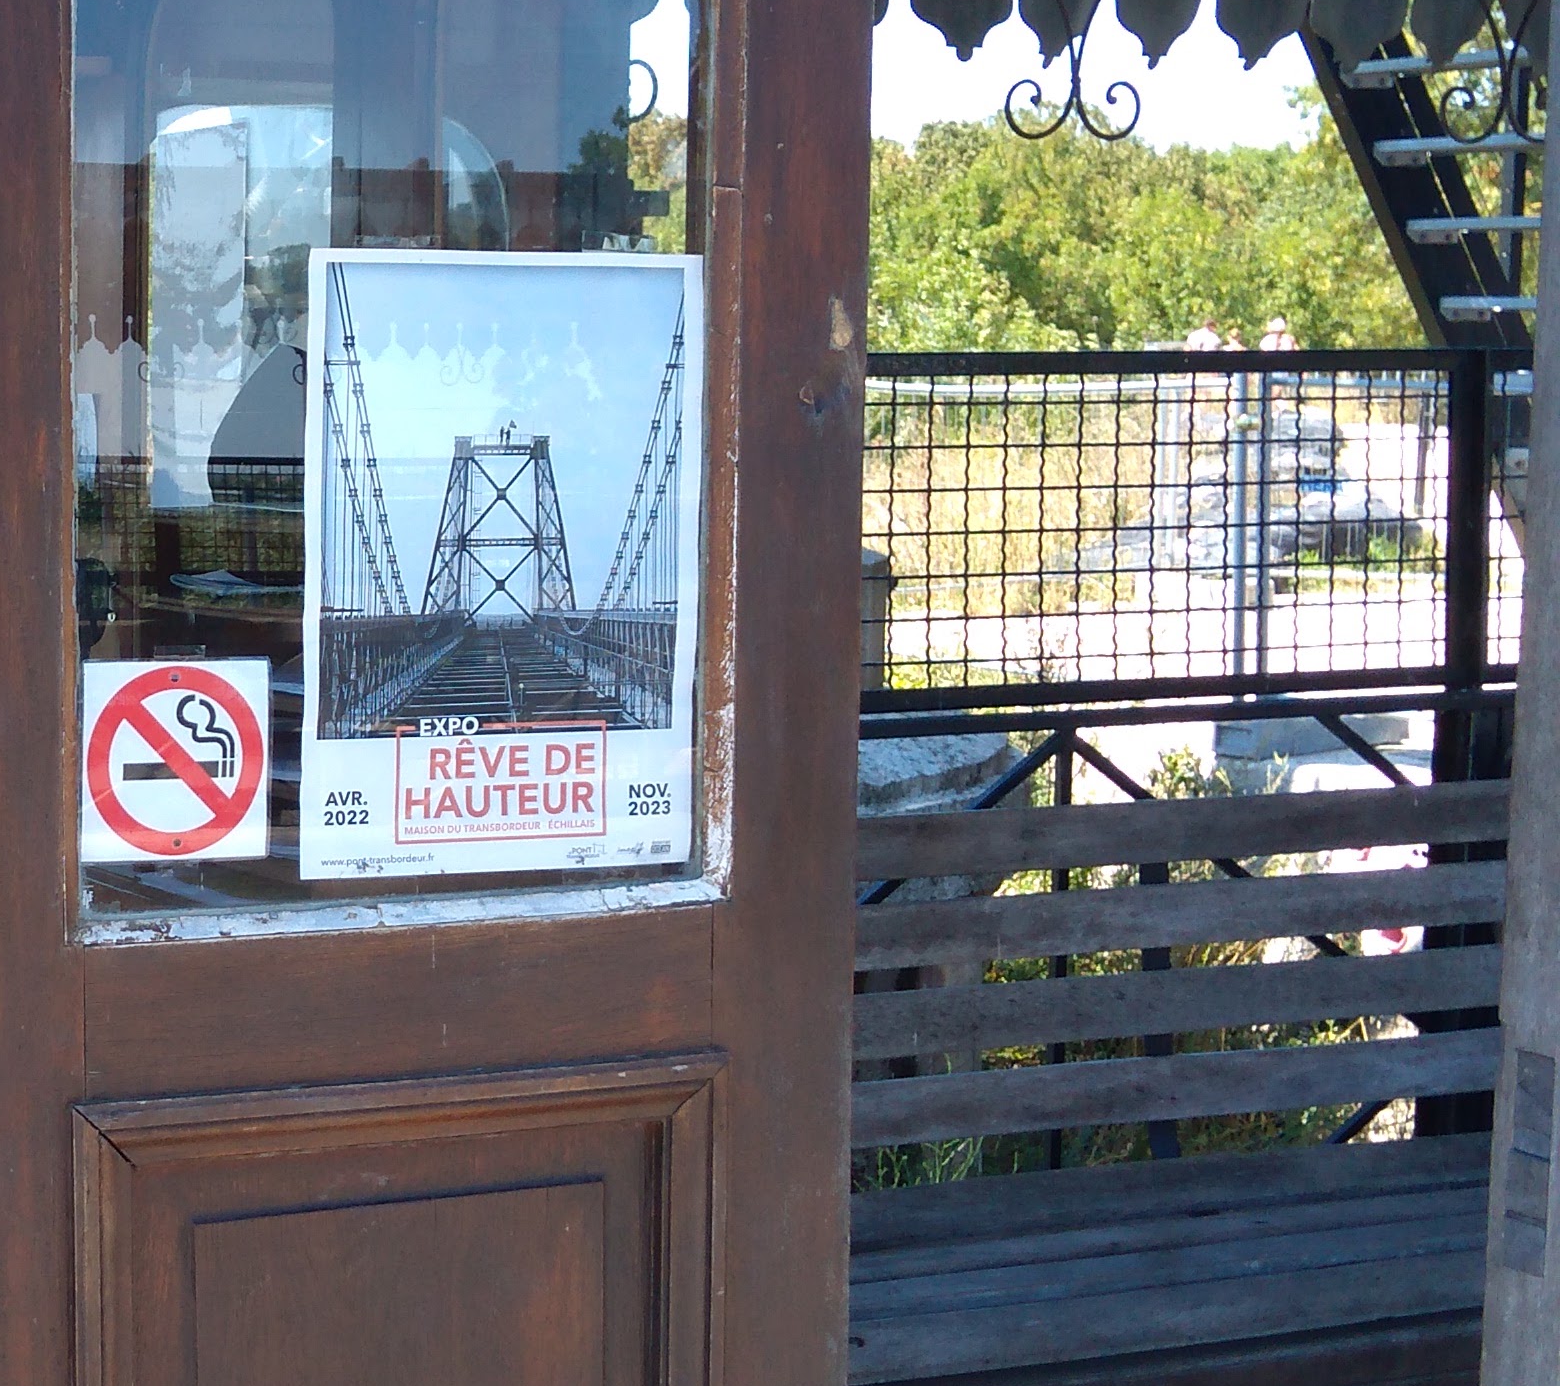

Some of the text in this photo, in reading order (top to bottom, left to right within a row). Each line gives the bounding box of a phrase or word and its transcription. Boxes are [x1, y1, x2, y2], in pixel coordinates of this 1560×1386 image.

[419, 716, 479, 737] EXPO
[429, 738, 596, 780] RÊVE DE
[325, 791, 369, 807] AVR.
[628, 782, 672, 799] NOV.
[405, 781, 595, 820] HAUTEUR
[628, 800, 671, 816] 2023
[323, 810, 370, 826] 2022
[404, 817, 596, 835] MAISON DU TRANSBORDEUR ÉCHILLAIS
[320, 852, 435, 868] www.pont-transbordeur.fr
